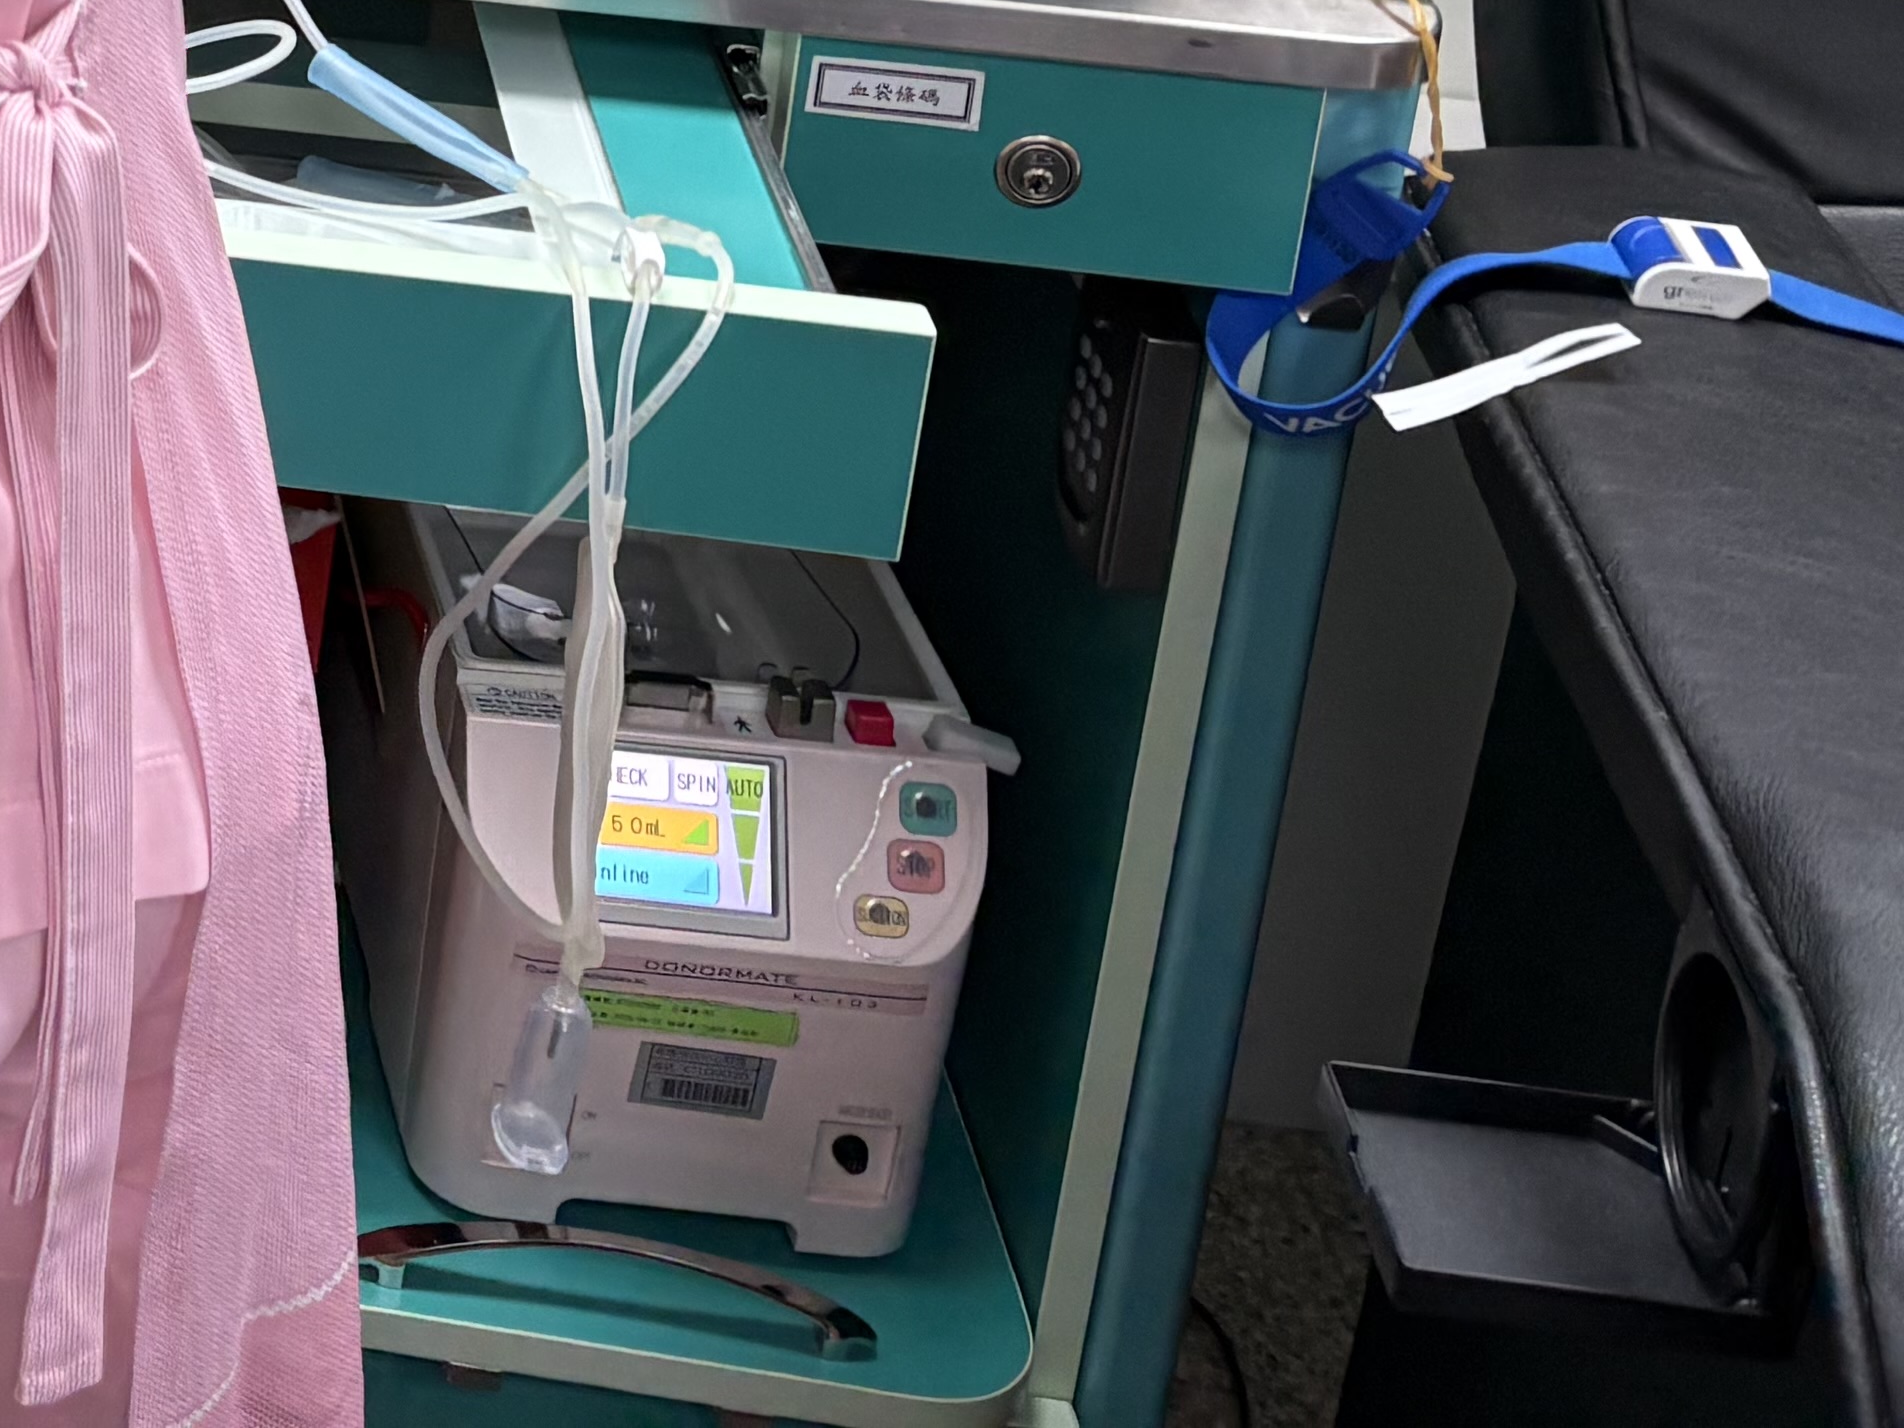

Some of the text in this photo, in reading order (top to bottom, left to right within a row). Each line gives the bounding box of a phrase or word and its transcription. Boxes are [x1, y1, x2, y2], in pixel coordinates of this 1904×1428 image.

[848, 80, 941, 107] 血袋條碼
[677, 772, 717, 794] SPIN
[725, 779, 764, 800] AUTO
[600, 863, 649, 885] nline
[644, 958, 800, 986] DONORMATE
